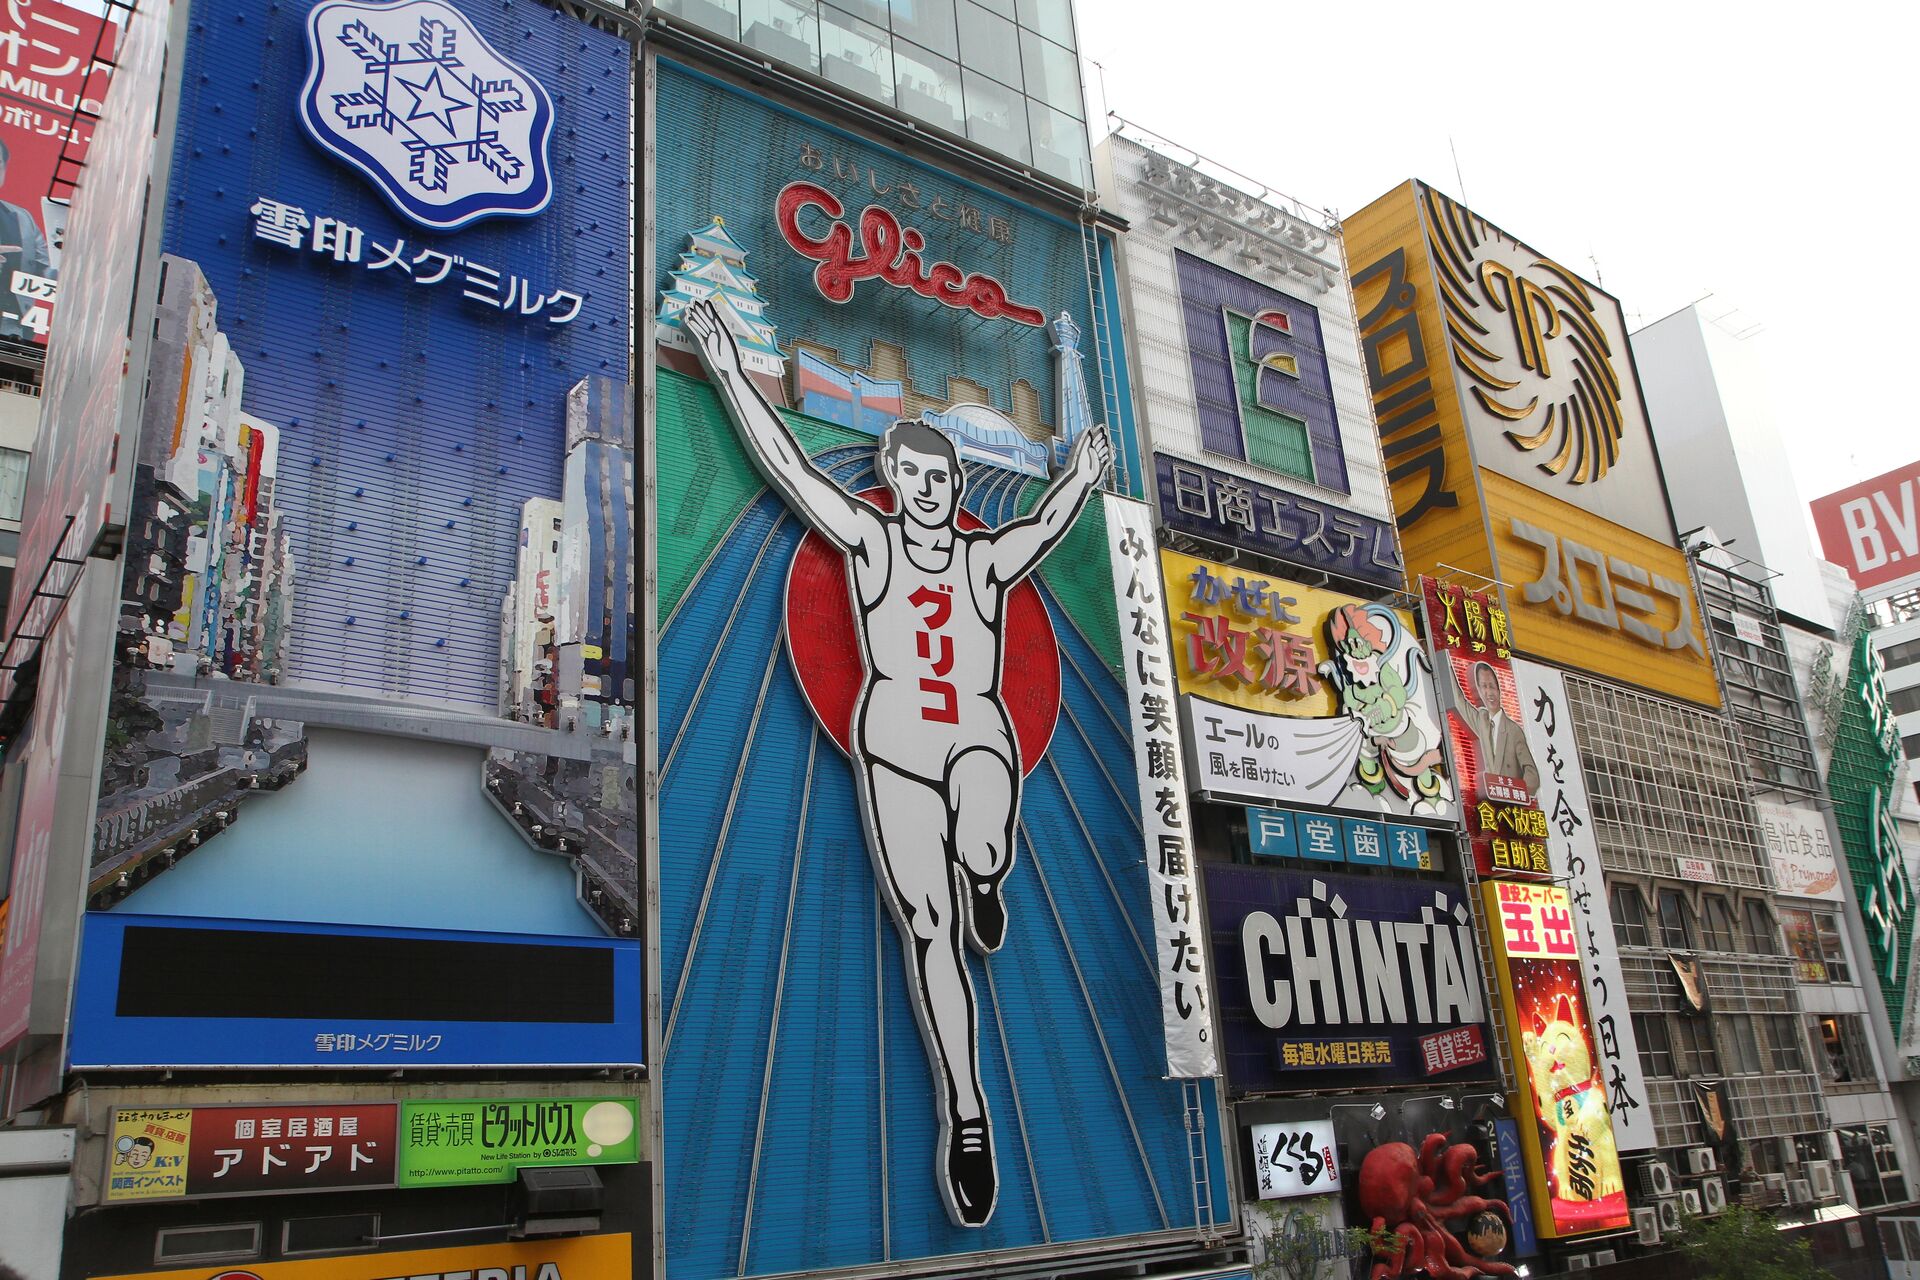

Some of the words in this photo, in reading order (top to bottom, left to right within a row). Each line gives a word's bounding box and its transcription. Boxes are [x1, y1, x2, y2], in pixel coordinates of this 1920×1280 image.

[800, 142, 1014, 245] おいしさと健康
[249, 196, 584, 327] 雪印メグミルク
[775, 180, 1046, 328] Glico
[1173, 464, 1404, 572] 日商エステム
[1511, 518, 1706, 658] プロミス
[907, 583, 960, 725] グリコ
[1180, 611, 1322, 698] 改源
[1204, 716, 1280, 751] エールの
[1119, 527, 1208, 1043] みんなに笑顔を届けたい。
[1209, 752, 1296, 787] 風を届けたい
[1257, 812, 1421, 862] 戸堂歯科
[1477, 802, 1548, 838] 食べ放題
[1492, 839, 1549, 872] 自助餐
[1534, 685, 1640, 1127] 力を合わせよう日本
[1501, 902, 1577, 954] 玉出
[1243, 900, 1485, 1029] CHINTAI
[314, 1033, 442, 1053] 雪印メグミルク
[1282, 1040, 1392, 1067] 毎週水曜日発売
[1422, 1035, 1457, 1072] 賃貸
[1453, 1029, 1472, 1048] 住宅
[1457, 1043, 1484, 1063] ニュース
[234, 1117, 358, 1141] 個室居酒屋
[481, 1102, 577, 1149] ピタットハウス
[213, 1142, 376, 1178] アドアド
[409, 1166, 504, 1178] http://www.pitatto.com/
[481, 1153, 495, 1161] New
[496, 1152, 508, 1161] Life
[509, 1151, 531, 1160] Station
[533, 1152, 542, 1160] by
[111, 1174, 184, 1190] 関西インベスト
